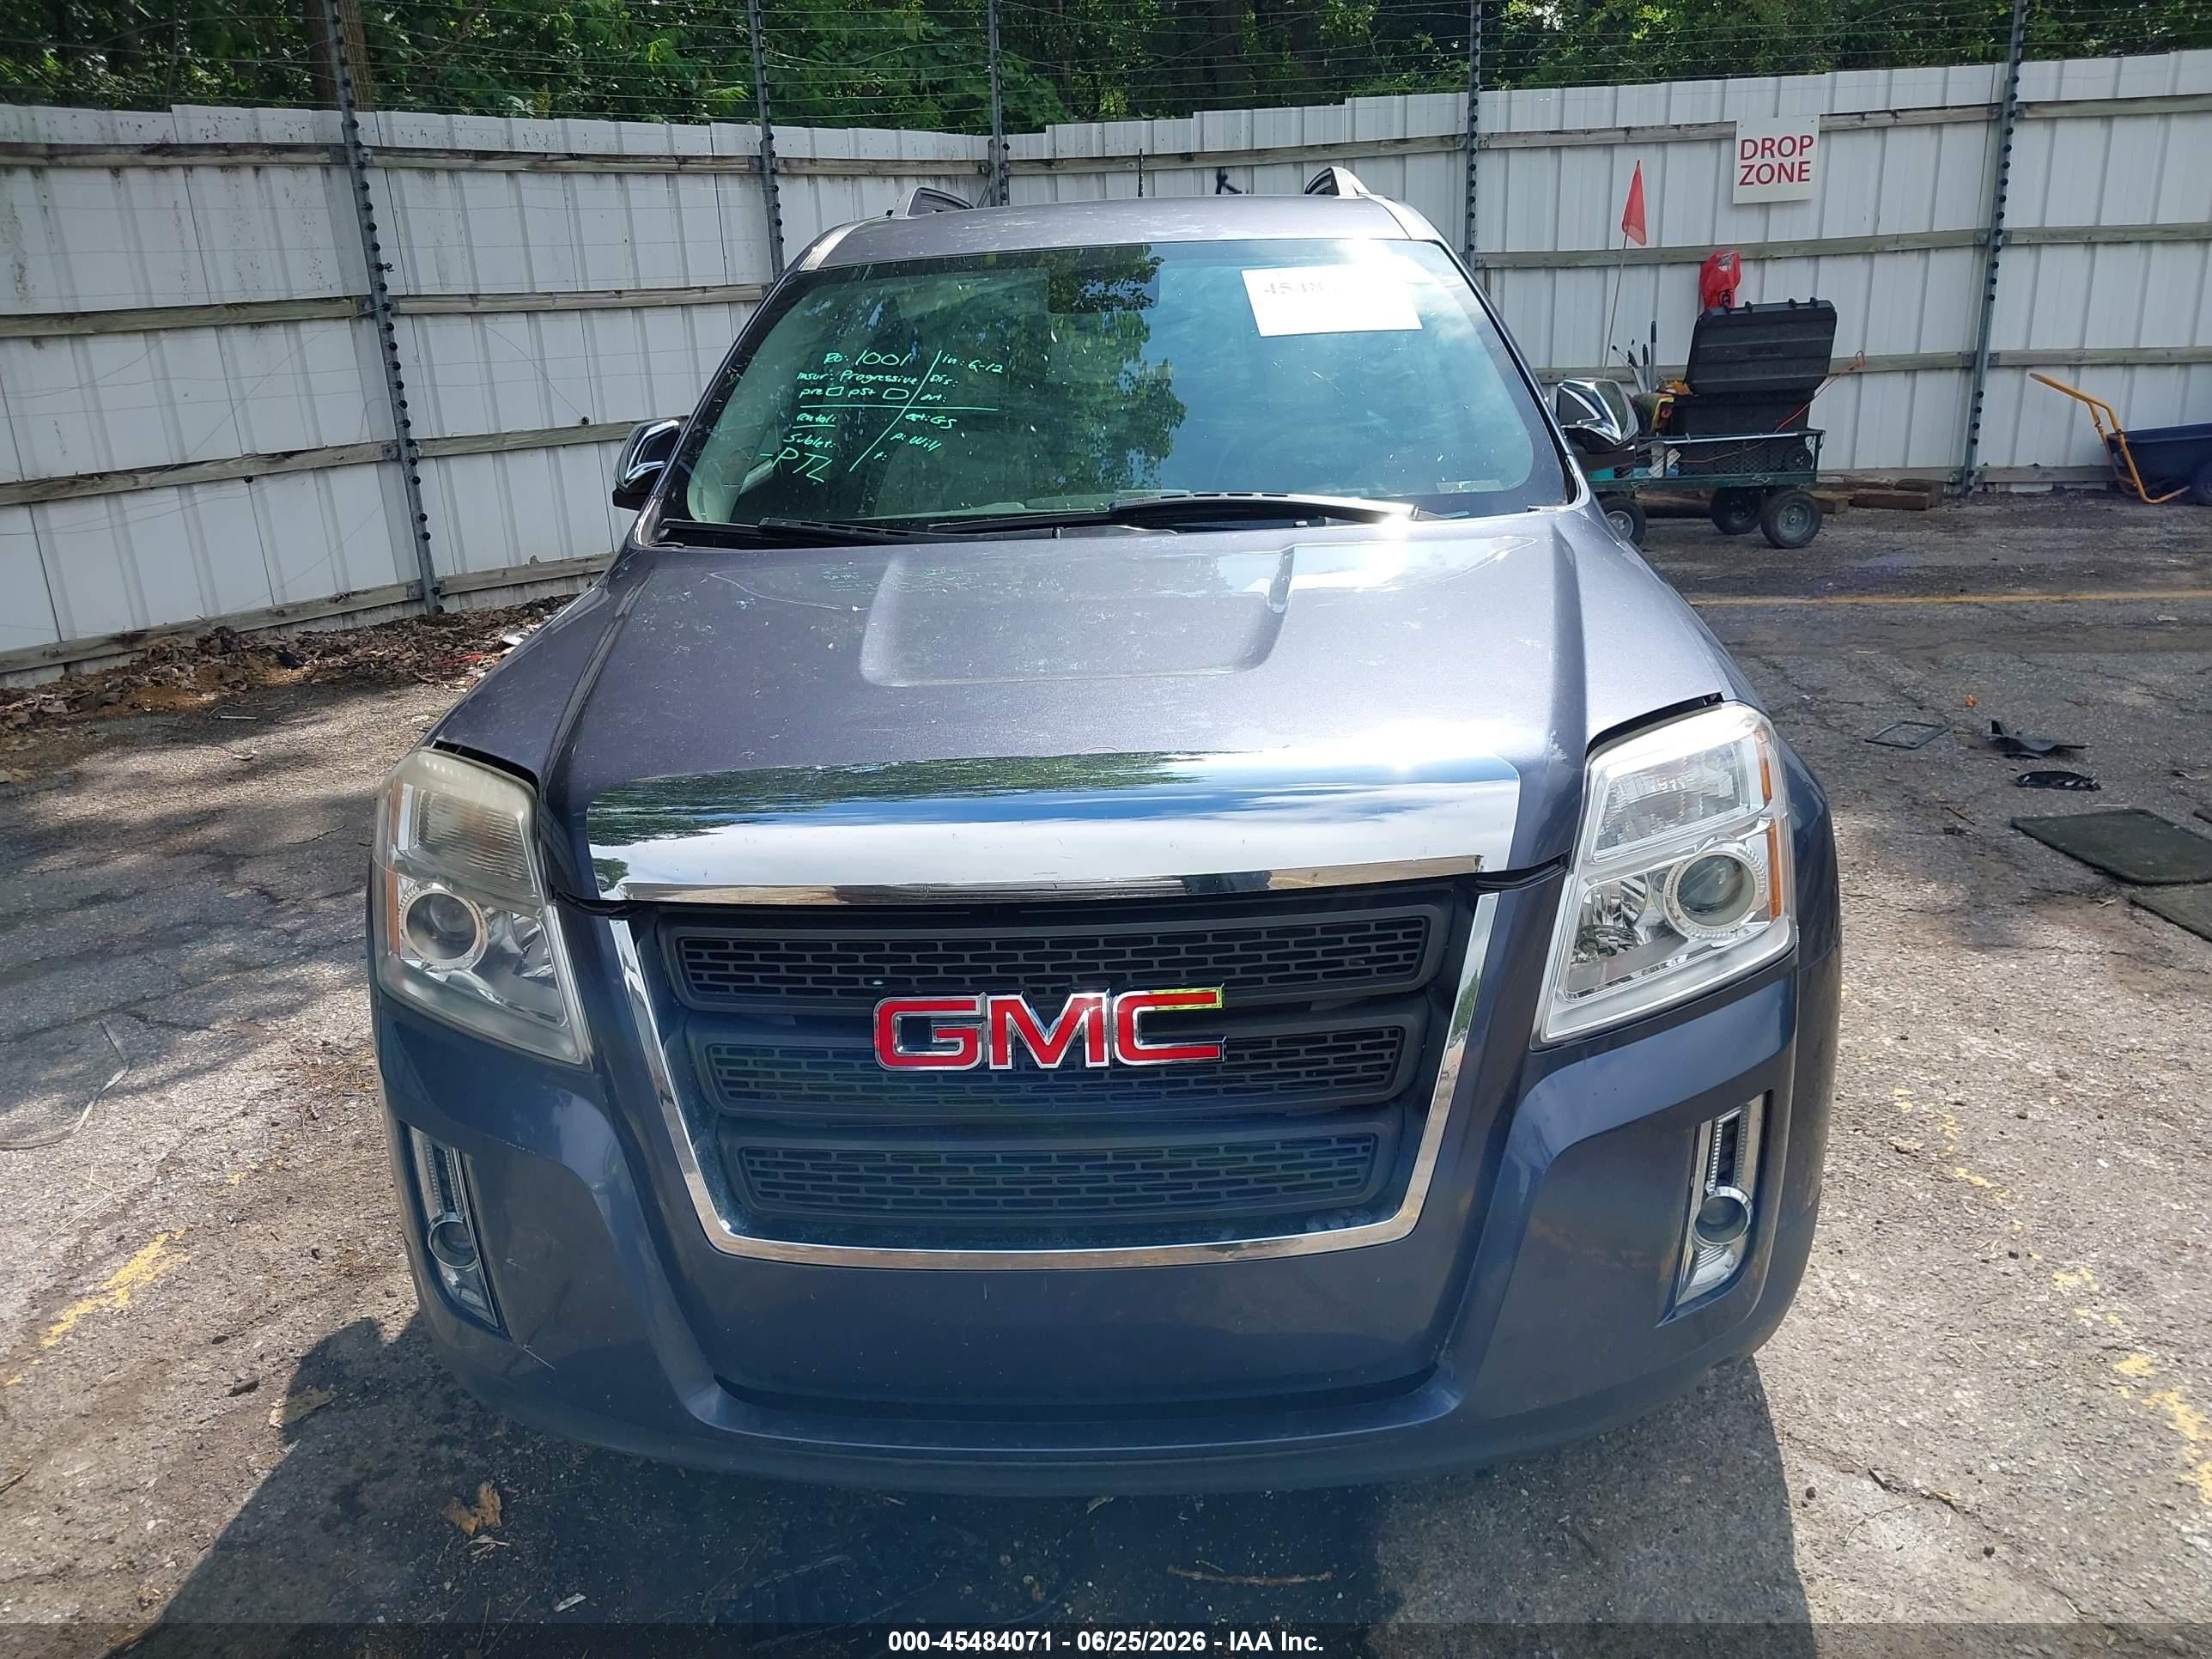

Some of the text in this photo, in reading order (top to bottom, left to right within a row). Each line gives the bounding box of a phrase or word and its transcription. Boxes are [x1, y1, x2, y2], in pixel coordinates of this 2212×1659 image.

[1740, 135, 1814, 161] DROP
[1739, 161, 1812, 186] ZONE
[854, 349, 912, 367] 1001
[839, 370, 920, 386] Progressive
[799, 386, 823, 399] pre
[908, 435, 942, 453] Will
[873, 983, 1227, 1071] GMC
